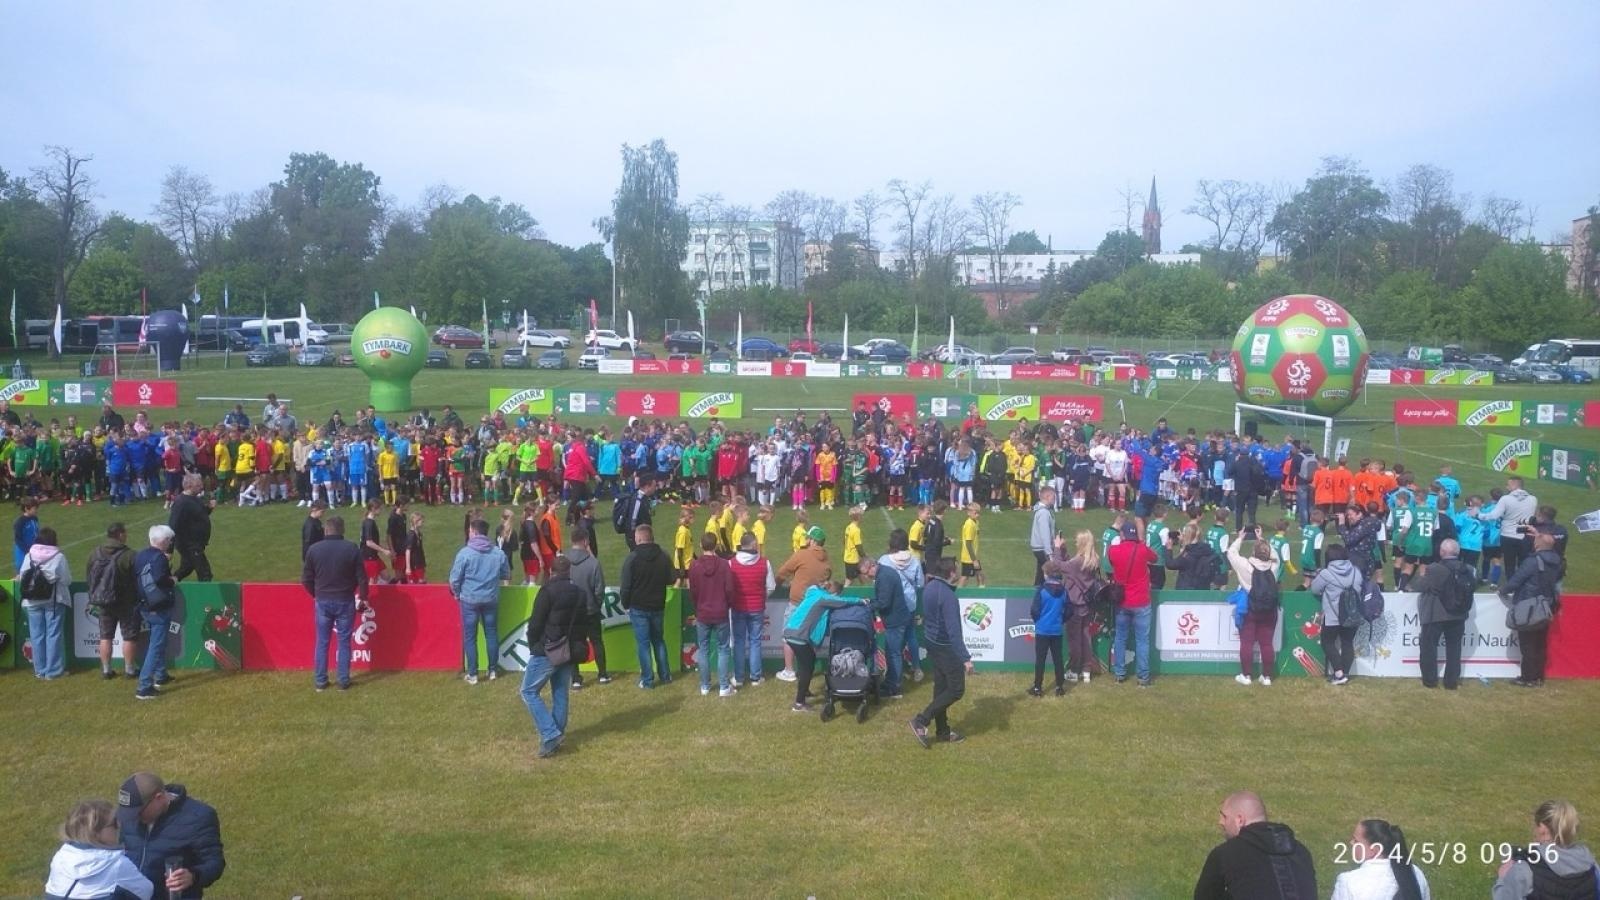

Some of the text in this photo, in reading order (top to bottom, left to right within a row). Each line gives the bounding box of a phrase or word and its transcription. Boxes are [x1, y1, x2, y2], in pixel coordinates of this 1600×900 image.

[364, 340, 409, 352] TYMBARK
[500, 389, 543, 413] TYMBARK
[690, 391, 731, 415] TYMBARK
[988, 395, 1030, 419] TYMBARK
[1468, 400, 1512, 425] TYMBARK
[1493, 439, 1530, 471] TYMBARK
[1417, 521, 1433, 537] 13
[1470, 521, 1479, 535] 2
[1479, 632, 1519, 647] Nauk
